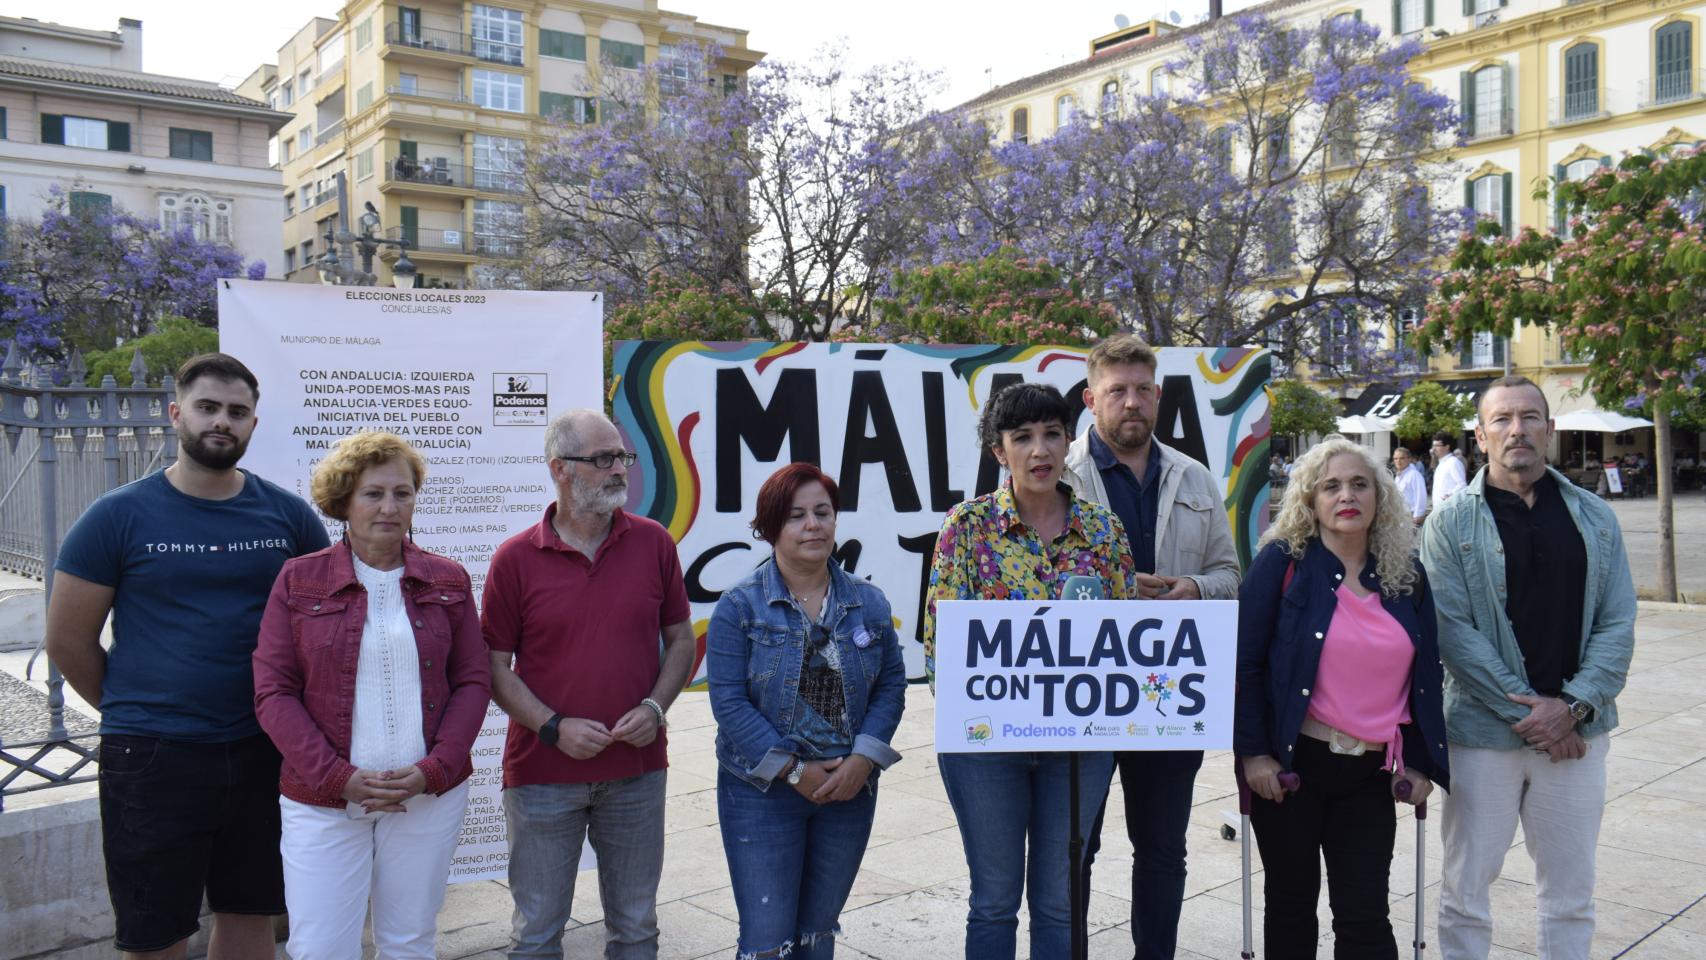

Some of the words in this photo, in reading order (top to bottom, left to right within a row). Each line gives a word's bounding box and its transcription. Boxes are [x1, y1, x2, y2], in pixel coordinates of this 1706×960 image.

[346, 291, 412, 302] ELECCIONES
[415, 293, 461, 303] LOCALES
[464, 294, 486, 304] 2023
[381, 304, 452, 315] CONCEJALES/AS
[281, 335, 327, 344] MUNICIPIO
[345, 336, 381, 345] MÁLAGA
[300, 370, 327, 380] CON
[331, 371, 407, 381] ANDALUCIA:
[411, 372, 475, 382] IZQUIERDA
[305, 385, 441, 395] UNIDA-PODEMOS-MAS
[444, 385, 470, 395] PAIS
[303, 398, 430, 408] ANDALUCIA-VERDES
[434, 398, 472, 409] EQUO-
[495, 395, 545, 406] Podemos
[317, 412, 380, 422] INICIATIVA
[383, 412, 408, 422] DEL
[411, 412, 460, 422] PUEBLO
[413, 425, 453, 435] VERDE
[457, 425, 482, 435] CON
[467, 456, 496, 466] (TONI)
[498, 455, 546, 465] (IZQUIERD
[457, 485, 512, 495] (IZQUIERDA
[515, 484, 547, 494] UNIDA)
[450, 495, 505, 506] (PODEMOS)
[455, 504, 498, 514] RAMIREZ
[501, 503, 543, 513] (VERDES
[459, 525, 484, 535] (MAS
[486, 524, 507, 533] PAIS
[146, 543, 206, 552] TOMMY
[228, 538, 288, 552] HILFIGER
[450, 544, 493, 554] (ALIANZA
[966, 606, 1207, 668] MÁLAGA
[966, 674, 1030, 700] CON
[1003, 723, 1077, 737] Podemos
[474, 805, 495, 815] PAIS
